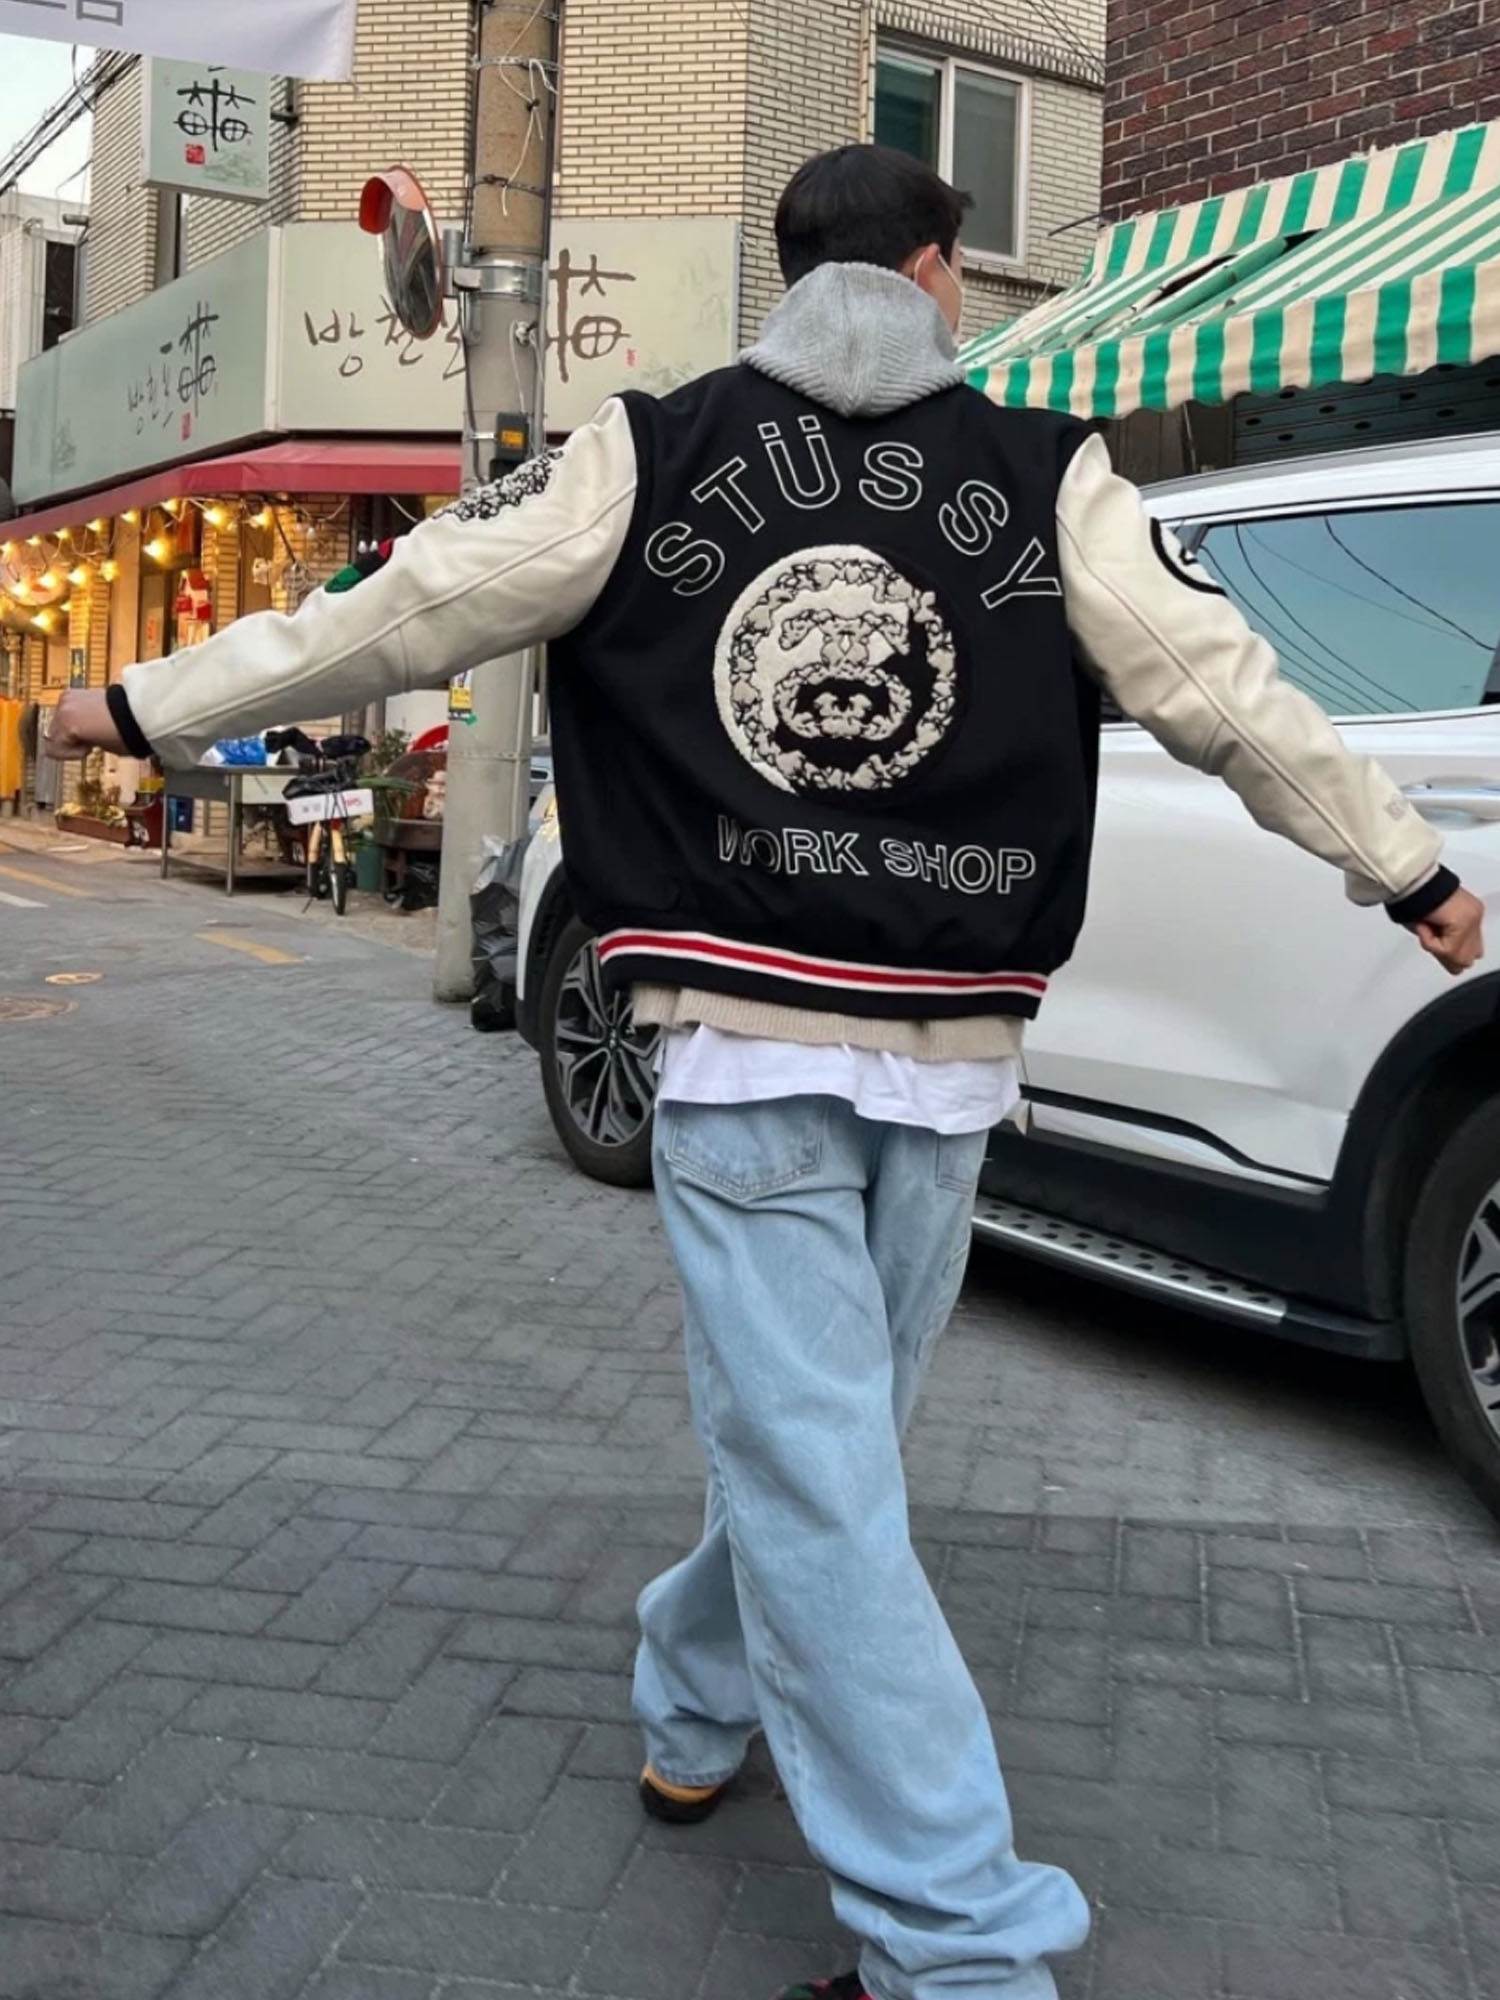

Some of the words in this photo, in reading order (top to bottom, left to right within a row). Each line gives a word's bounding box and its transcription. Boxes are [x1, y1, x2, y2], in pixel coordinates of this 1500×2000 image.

[644, 415, 1063, 610] STÜSSY
[717, 815, 868, 875] WORK
[879, 838, 1036, 894] SHOP
